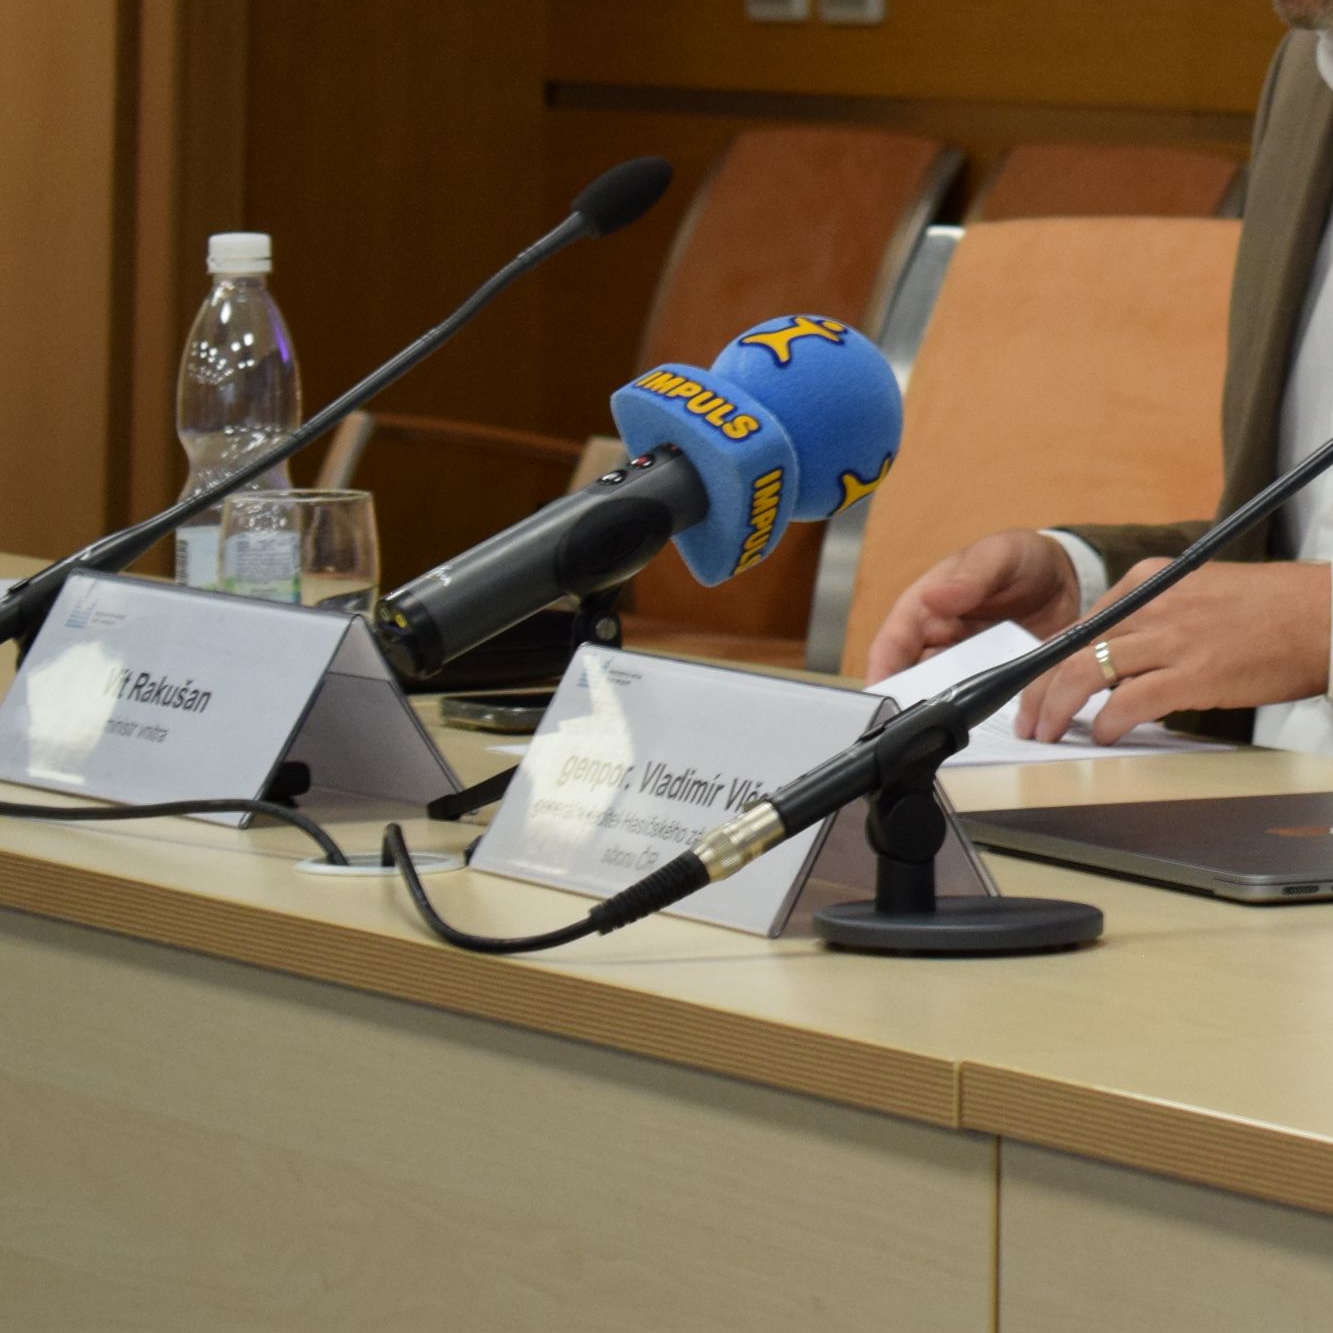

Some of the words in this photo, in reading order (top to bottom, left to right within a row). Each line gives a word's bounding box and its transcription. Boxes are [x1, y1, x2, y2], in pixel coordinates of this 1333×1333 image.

[633, 370, 761, 441] IMPULS
[127, 671, 213, 714] Rakušan
[638, 760, 725, 811] Vladimír
